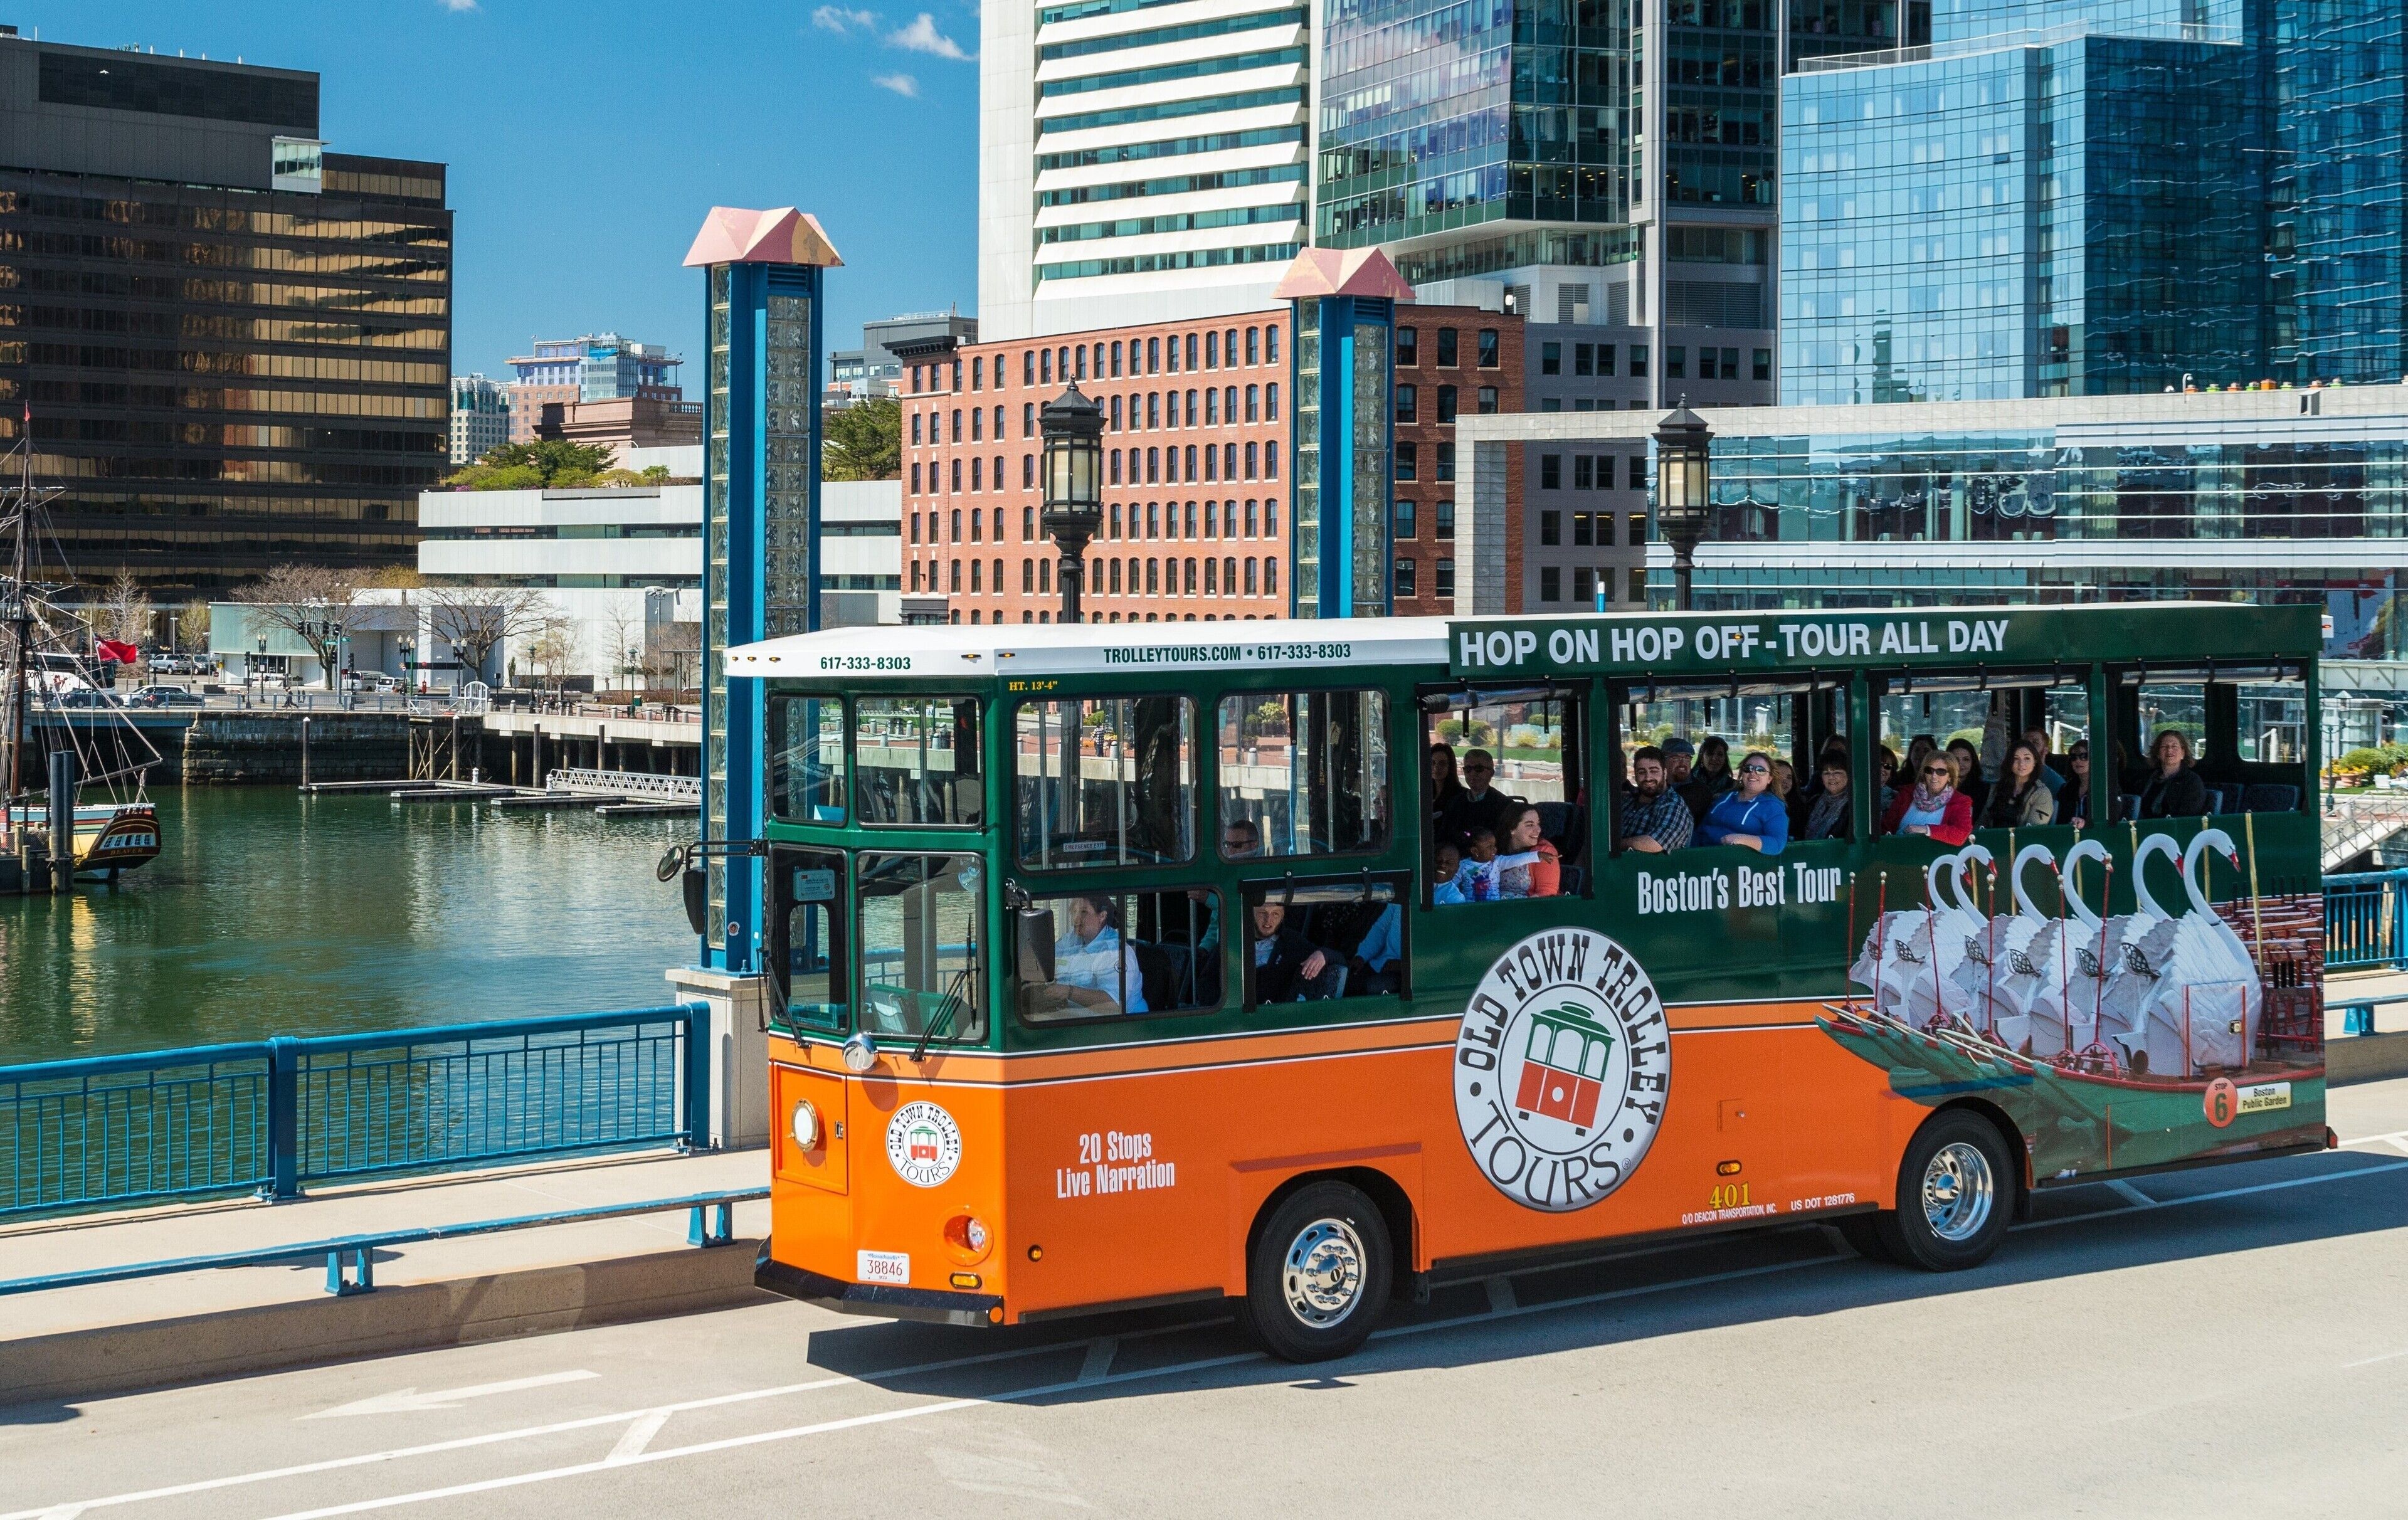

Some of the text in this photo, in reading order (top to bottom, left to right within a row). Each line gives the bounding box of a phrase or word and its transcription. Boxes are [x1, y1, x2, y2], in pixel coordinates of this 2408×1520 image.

[1104, 644, 1351, 663] TROLLEYTOURS.COM 617-333-8303
[1460, 631, 1537, 666] HOP
[1549, 629, 1599, 663] ON
[1612, 627, 1684, 662] HOP
[1880, 621, 1938, 654] ALL
[1948, 620, 2009, 652] DAY
[820, 657, 911, 670] 617-333-8303
[1009, 680, 1058, 691] HT. 13'-4"
[1638, 862, 1841, 914] Boston's Best Tour
[1459, 933, 1667, 1126] OLD TOWN TROLLEY
[2215, 1082, 2227, 1090] STOP
[2254, 1087, 2276, 1097] Boston
[2214, 1093, 2228, 1122] 6
[2242, 1095, 2287, 1109] Public Garden
[889, 1105, 958, 1154] OLD TOWN TROLLEY
[1079, 1131, 1152, 1164] 20 Stops
[1470, 1099, 1621, 1207] TOURS
[900, 1157, 950, 1183] TOURS
[1057, 1159, 1175, 1199] Live Narration
[1708, 1181, 1751, 1210] 401
[1790, 1193, 1855, 1211] US DOT 1281776
[1694, 1211, 1717, 1223] DEACON
[1766, 1203, 1777, 1214] INC.
[867, 1259, 902, 1276] 38846
